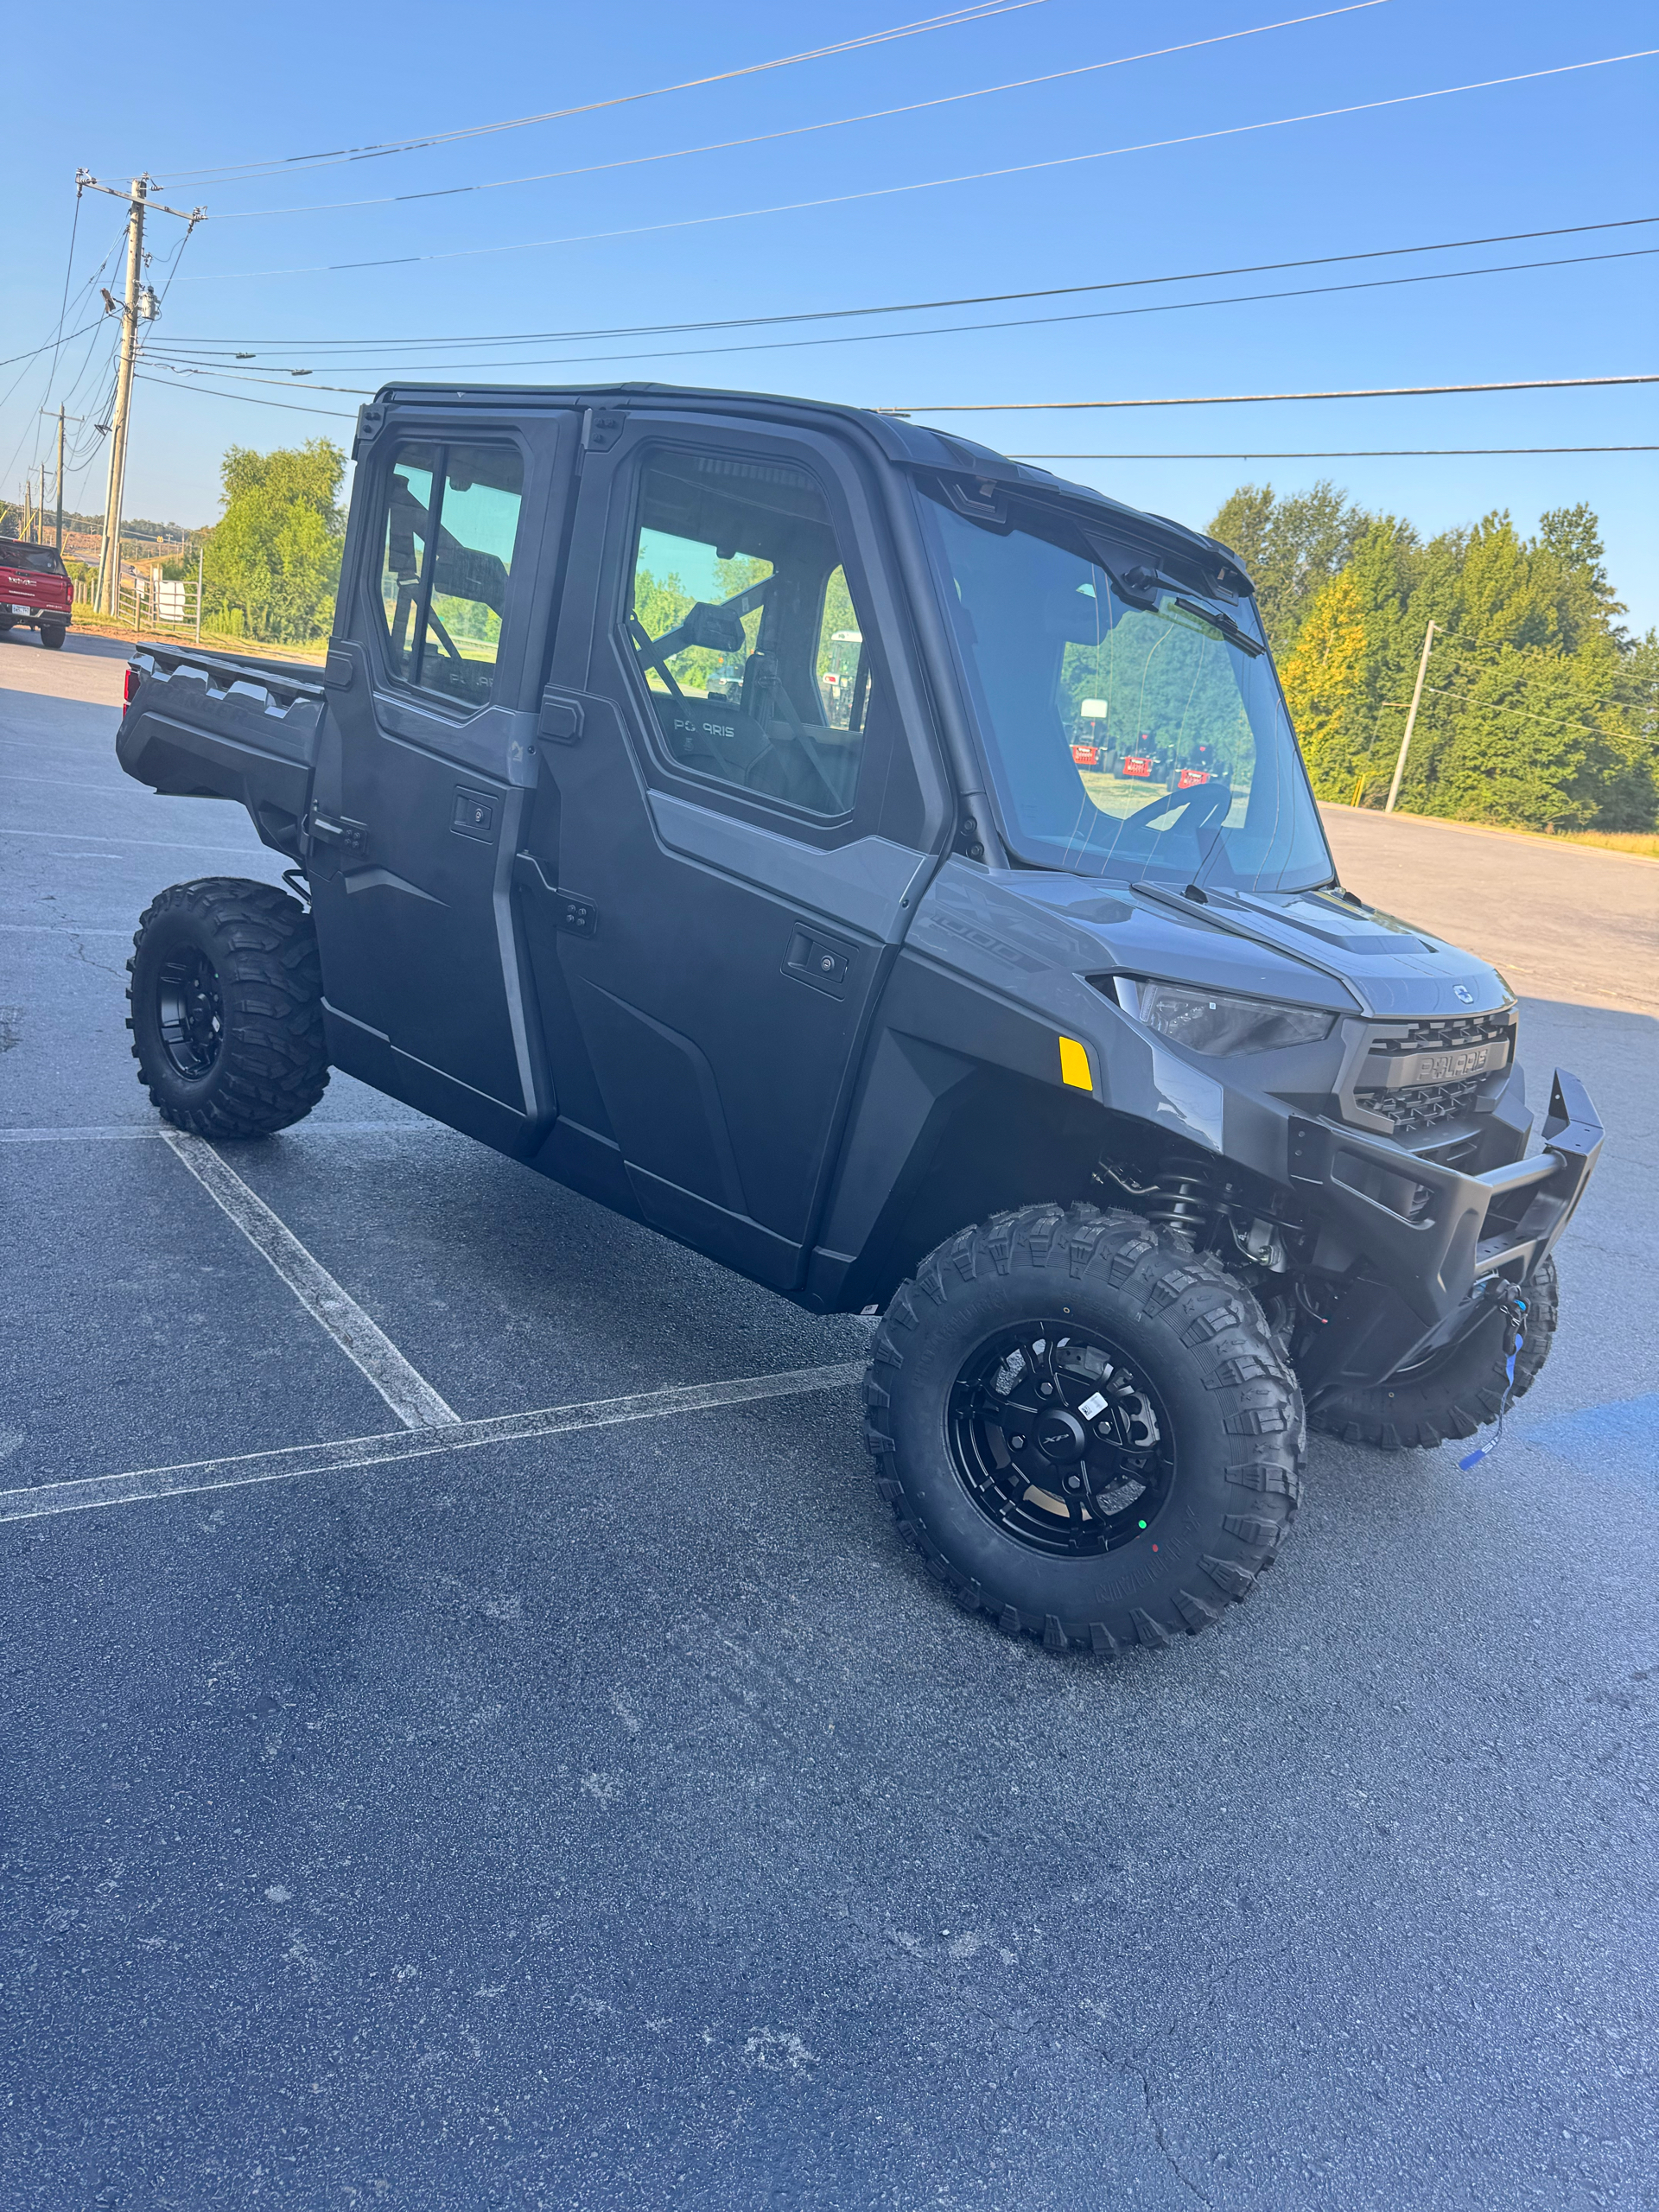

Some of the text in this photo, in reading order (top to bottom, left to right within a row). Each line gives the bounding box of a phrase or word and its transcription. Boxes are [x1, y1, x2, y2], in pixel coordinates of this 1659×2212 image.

[674, 719, 734, 737] POARIS
[1418, 1049, 1487, 1080] POLARIS
[1043, 1434, 1069, 1444] XP
